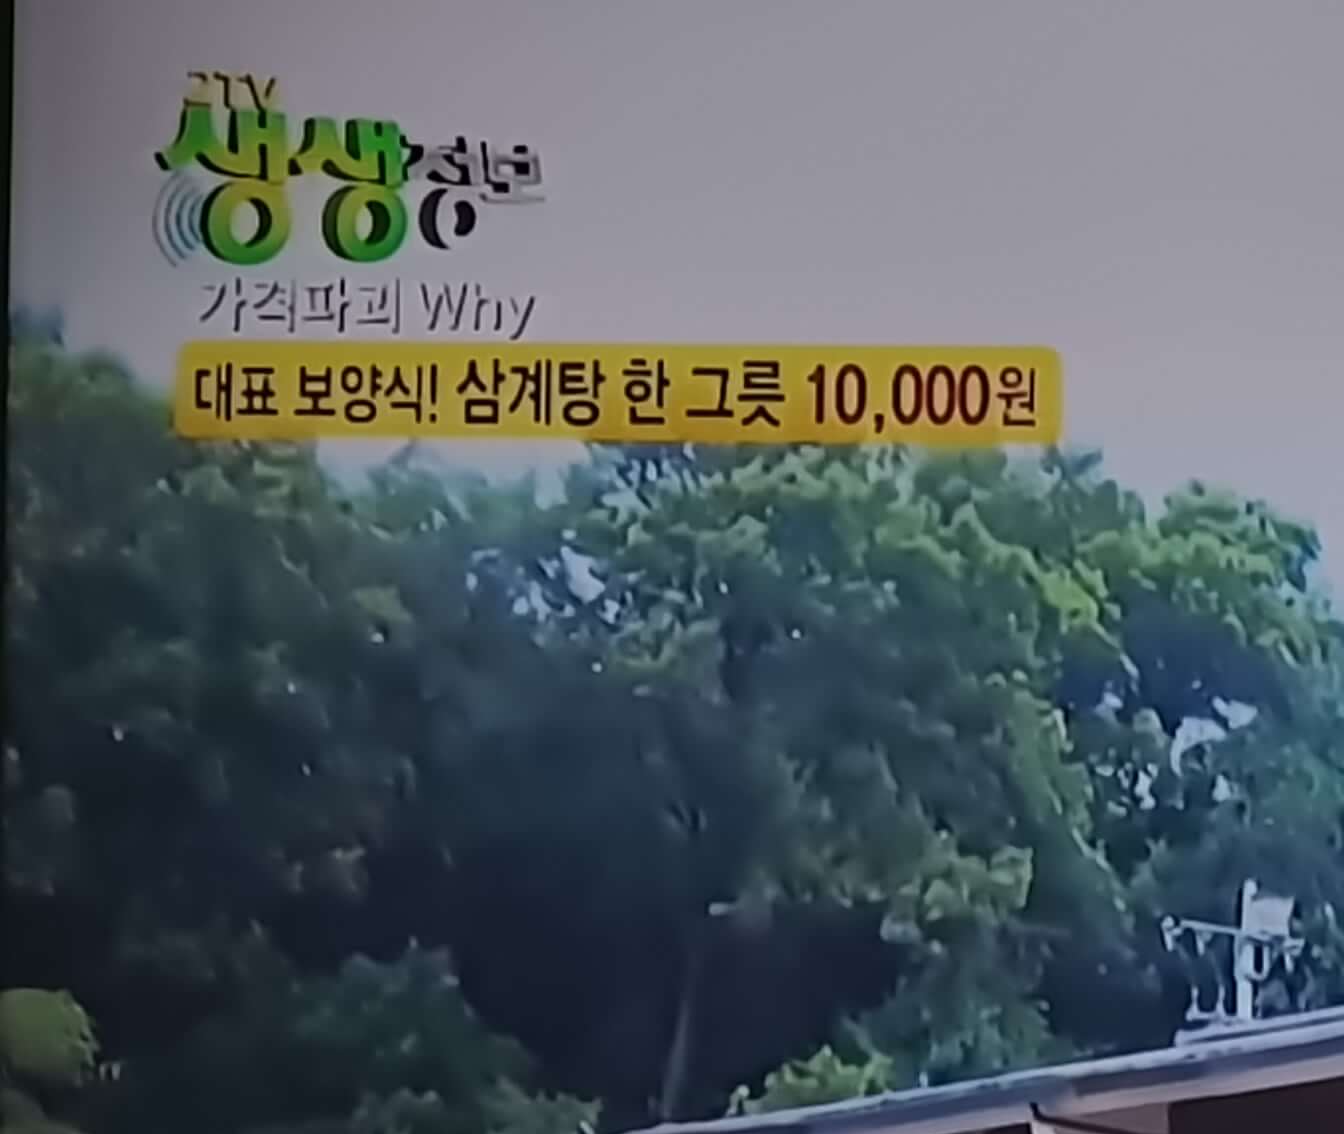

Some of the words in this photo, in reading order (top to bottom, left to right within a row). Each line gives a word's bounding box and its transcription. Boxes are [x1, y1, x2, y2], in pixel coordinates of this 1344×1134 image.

[198, 278, 402, 334] 가격파괴
[419, 282, 536, 340] Why
[193, 366, 276, 423] 대표
[295, 366, 439, 425] 보양식!
[456, 362, 602, 428] 삼계탕
[622, 360, 671, 426] 한
[686, 363, 787, 427] 그릇
[806, 365, 1038, 434] 10,000원
